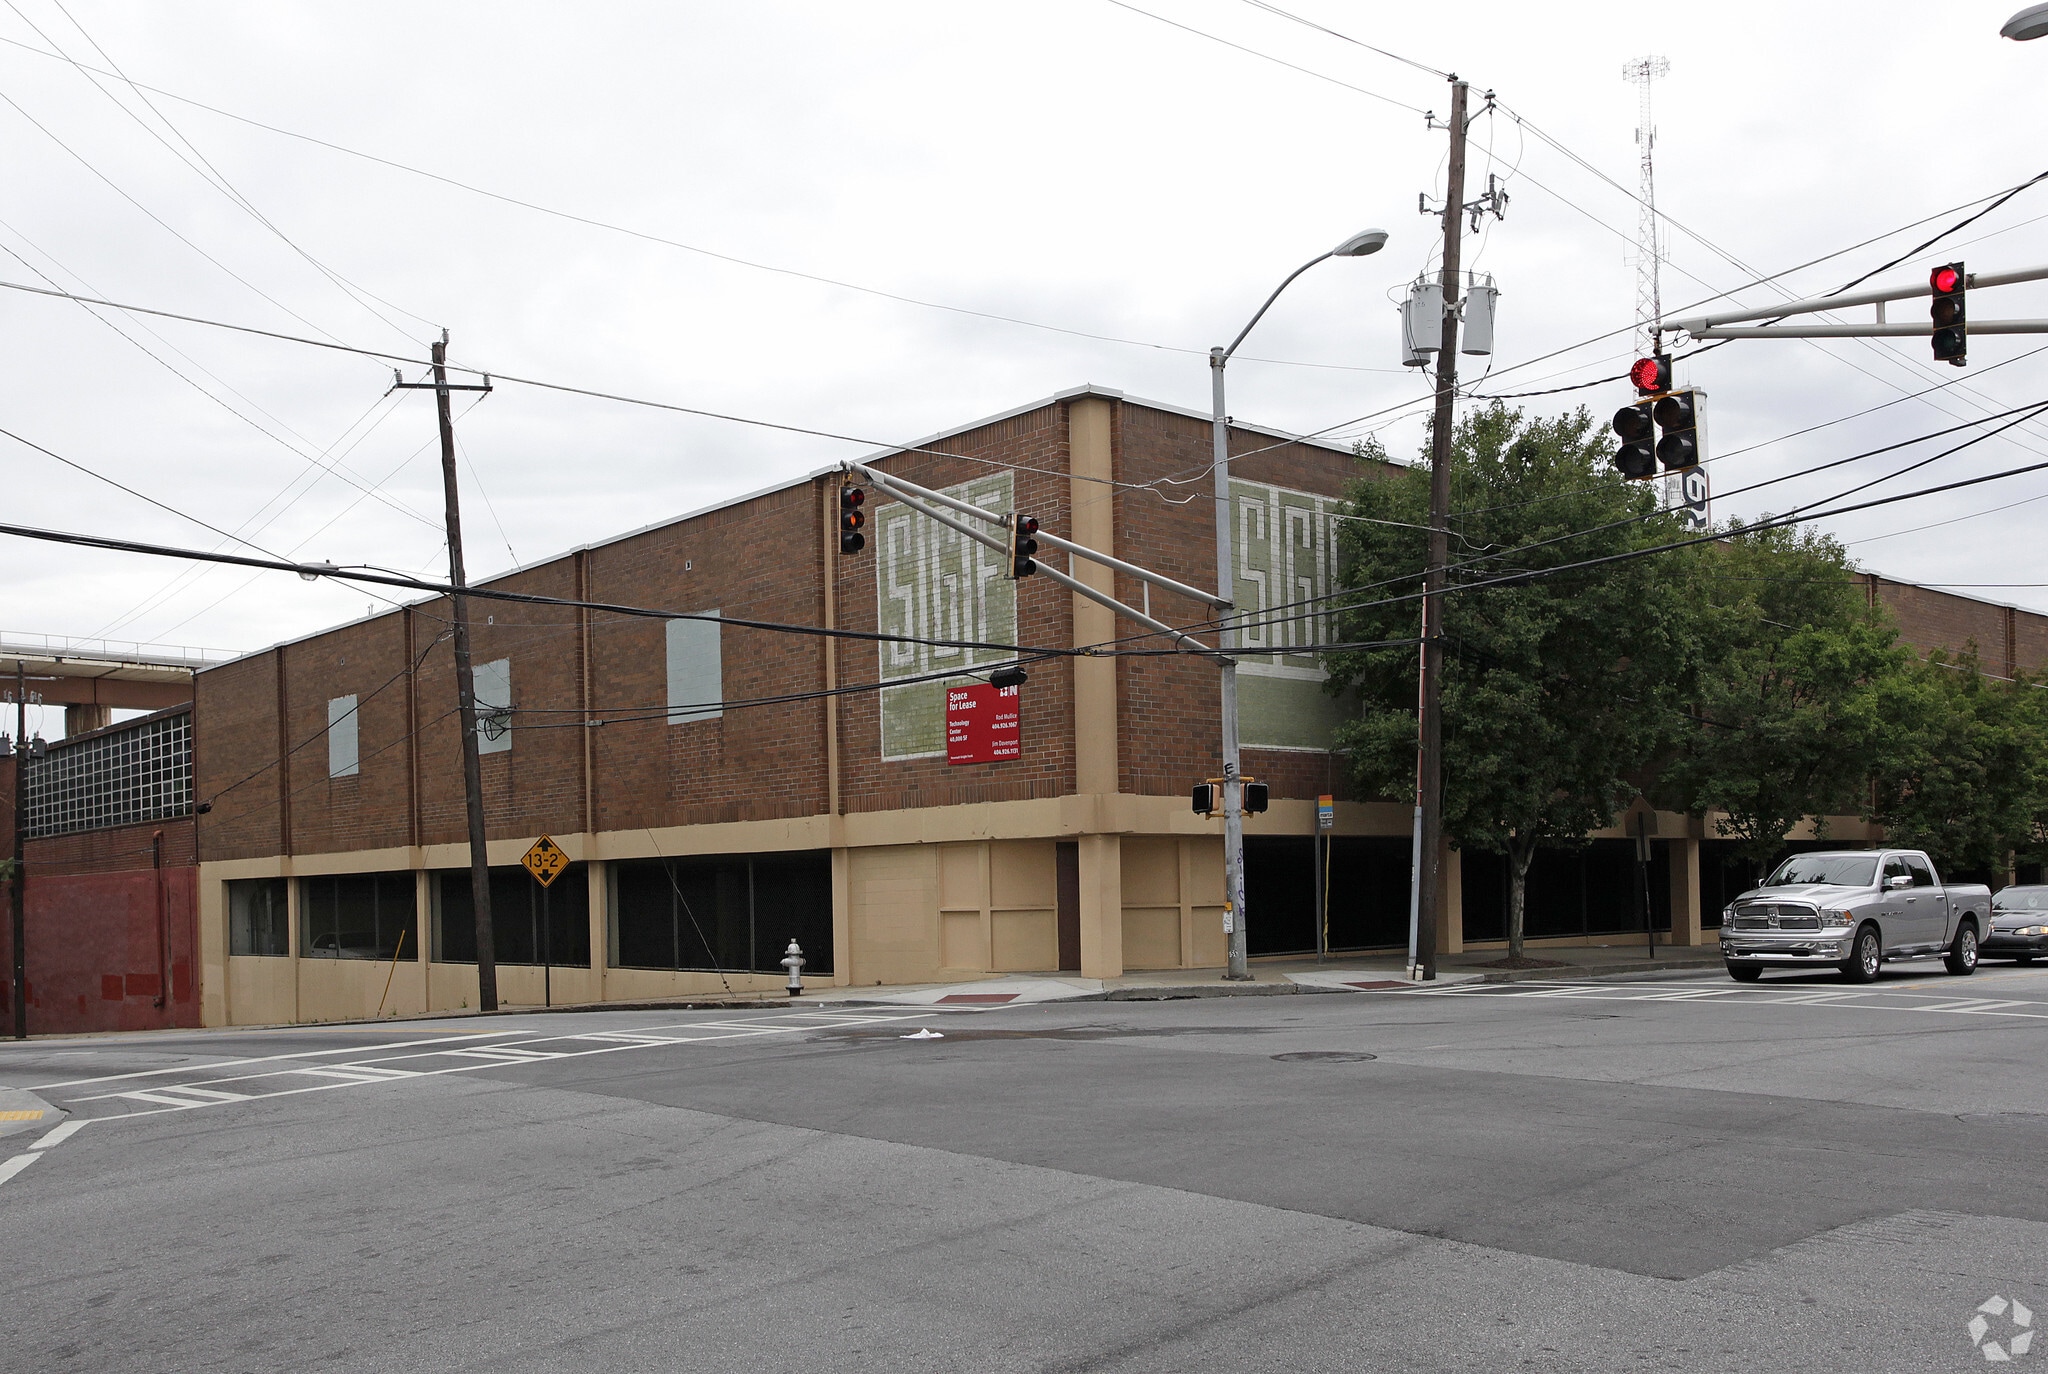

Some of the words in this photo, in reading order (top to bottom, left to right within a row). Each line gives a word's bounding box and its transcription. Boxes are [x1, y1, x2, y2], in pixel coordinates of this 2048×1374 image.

[949, 692, 968, 702] Space
[949, 702, 959, 711] for
[959, 700, 977, 710] Lease
